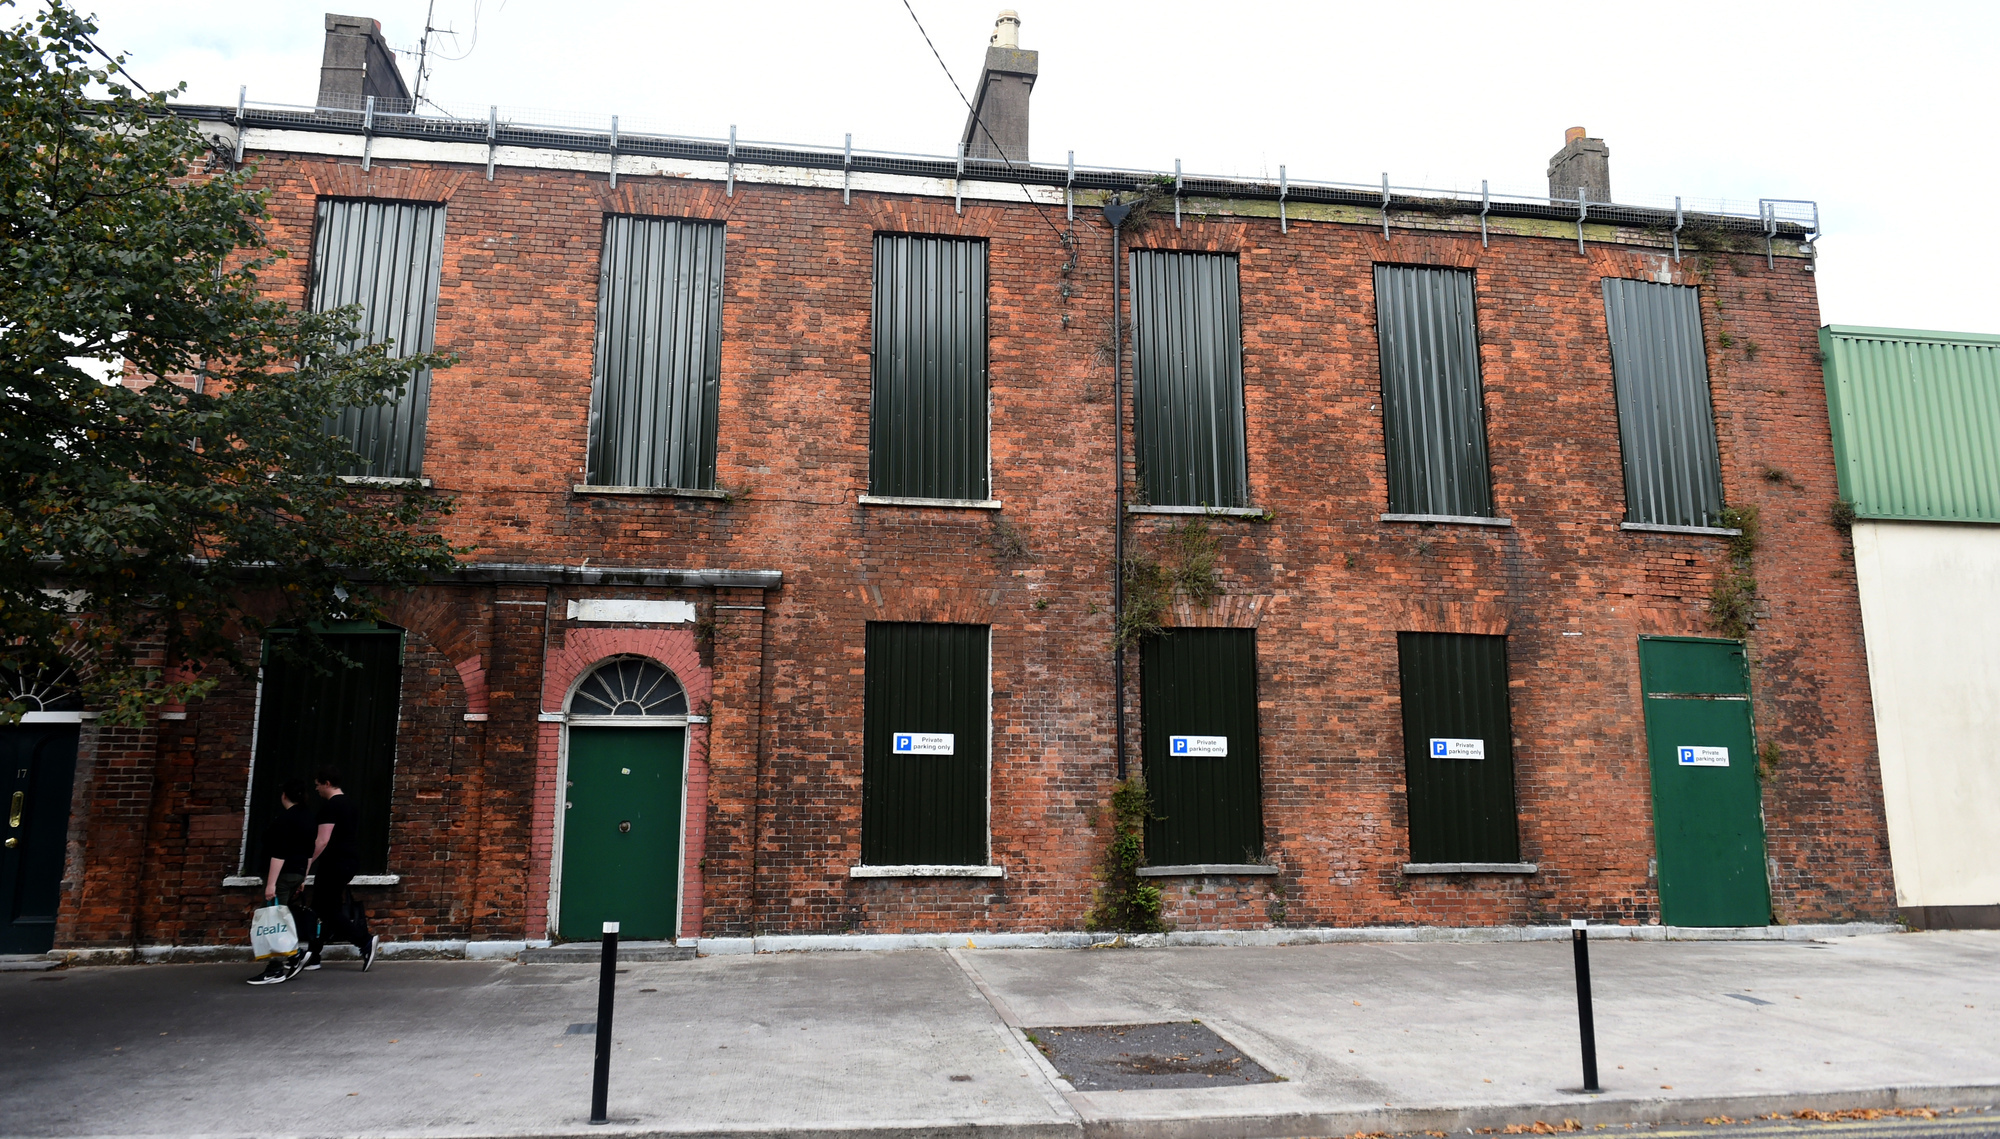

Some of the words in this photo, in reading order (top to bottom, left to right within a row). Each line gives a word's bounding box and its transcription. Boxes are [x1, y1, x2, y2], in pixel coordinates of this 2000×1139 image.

[900, 738, 909, 749] P
[1177, 741, 1185, 751] P
[1436, 743, 1445, 753] P
[1684, 750, 1692, 760] P
[16, 768, 28, 779] 17
[256, 922, 288, 937] Dealz
